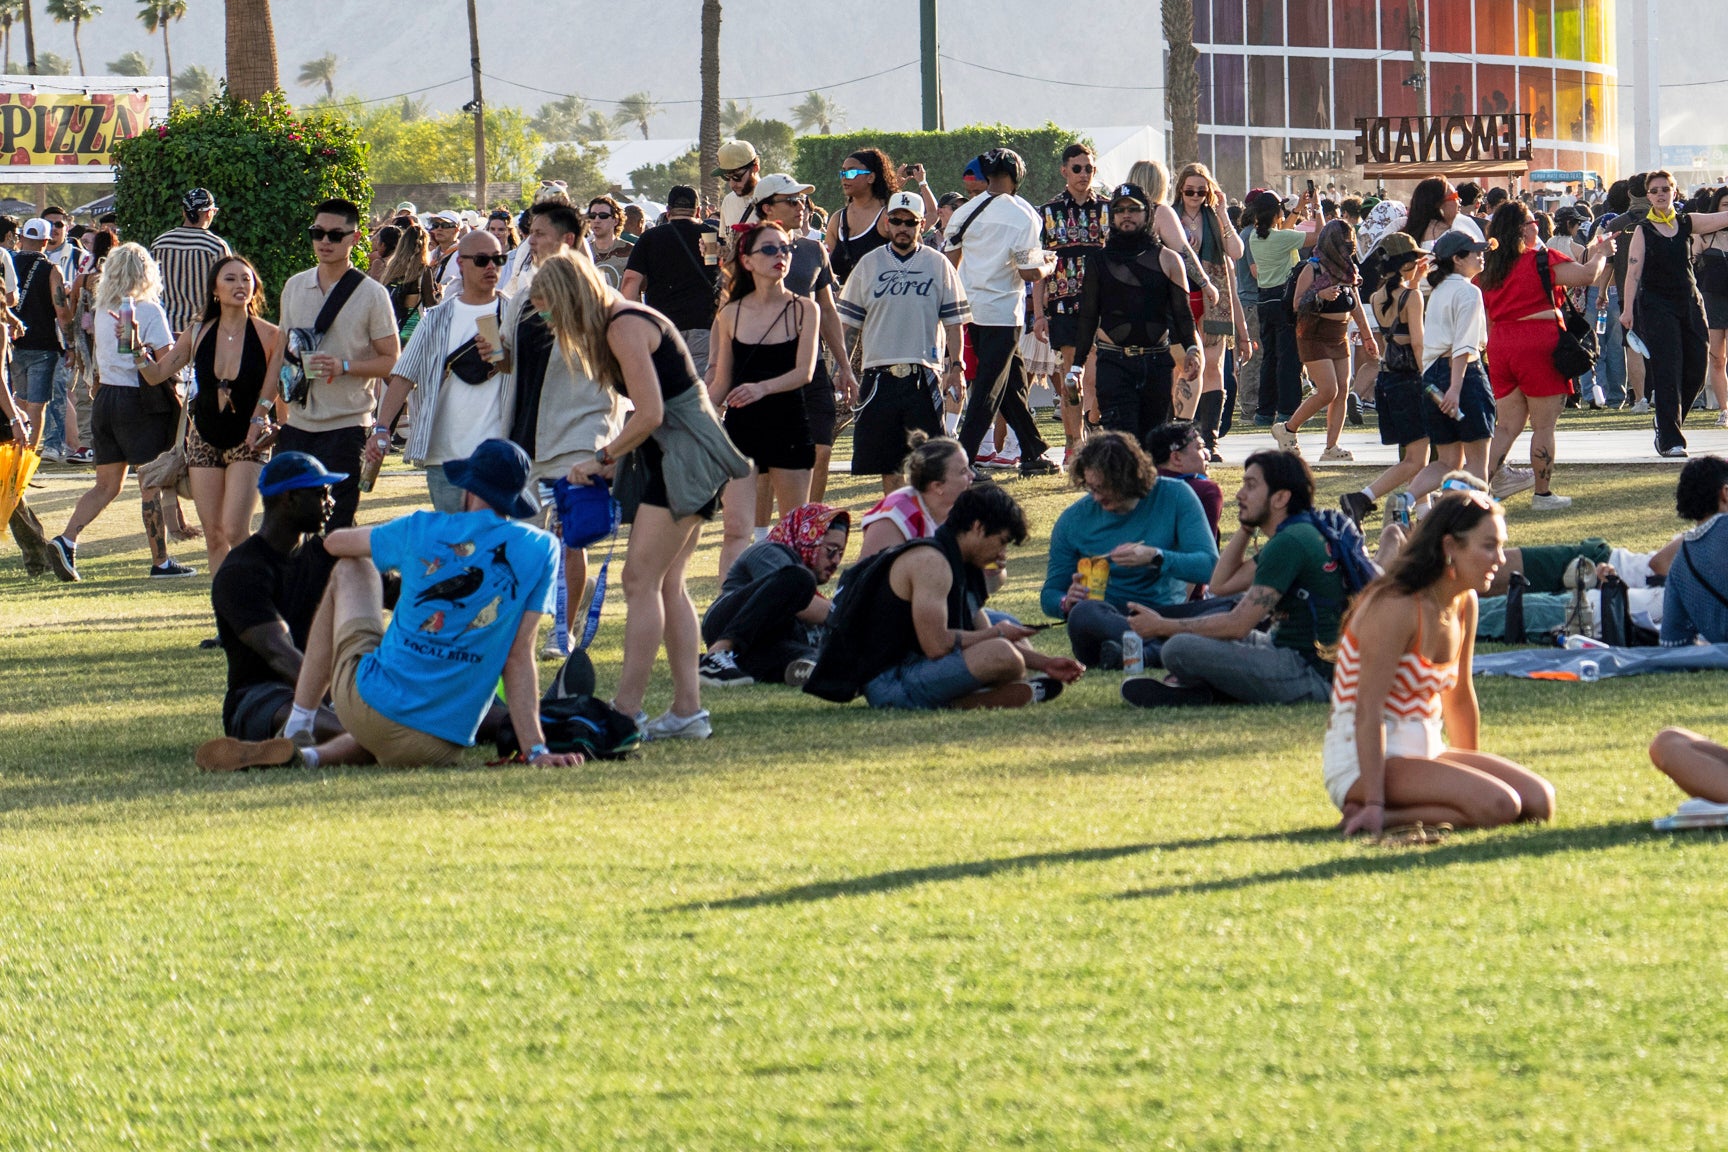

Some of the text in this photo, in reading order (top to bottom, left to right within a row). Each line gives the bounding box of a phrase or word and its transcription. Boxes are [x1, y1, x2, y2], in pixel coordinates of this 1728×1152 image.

[0, 104, 132, 153] PIZZA
[874, 270, 934, 298] Ford
[403, 638, 444, 659] LOCAL
